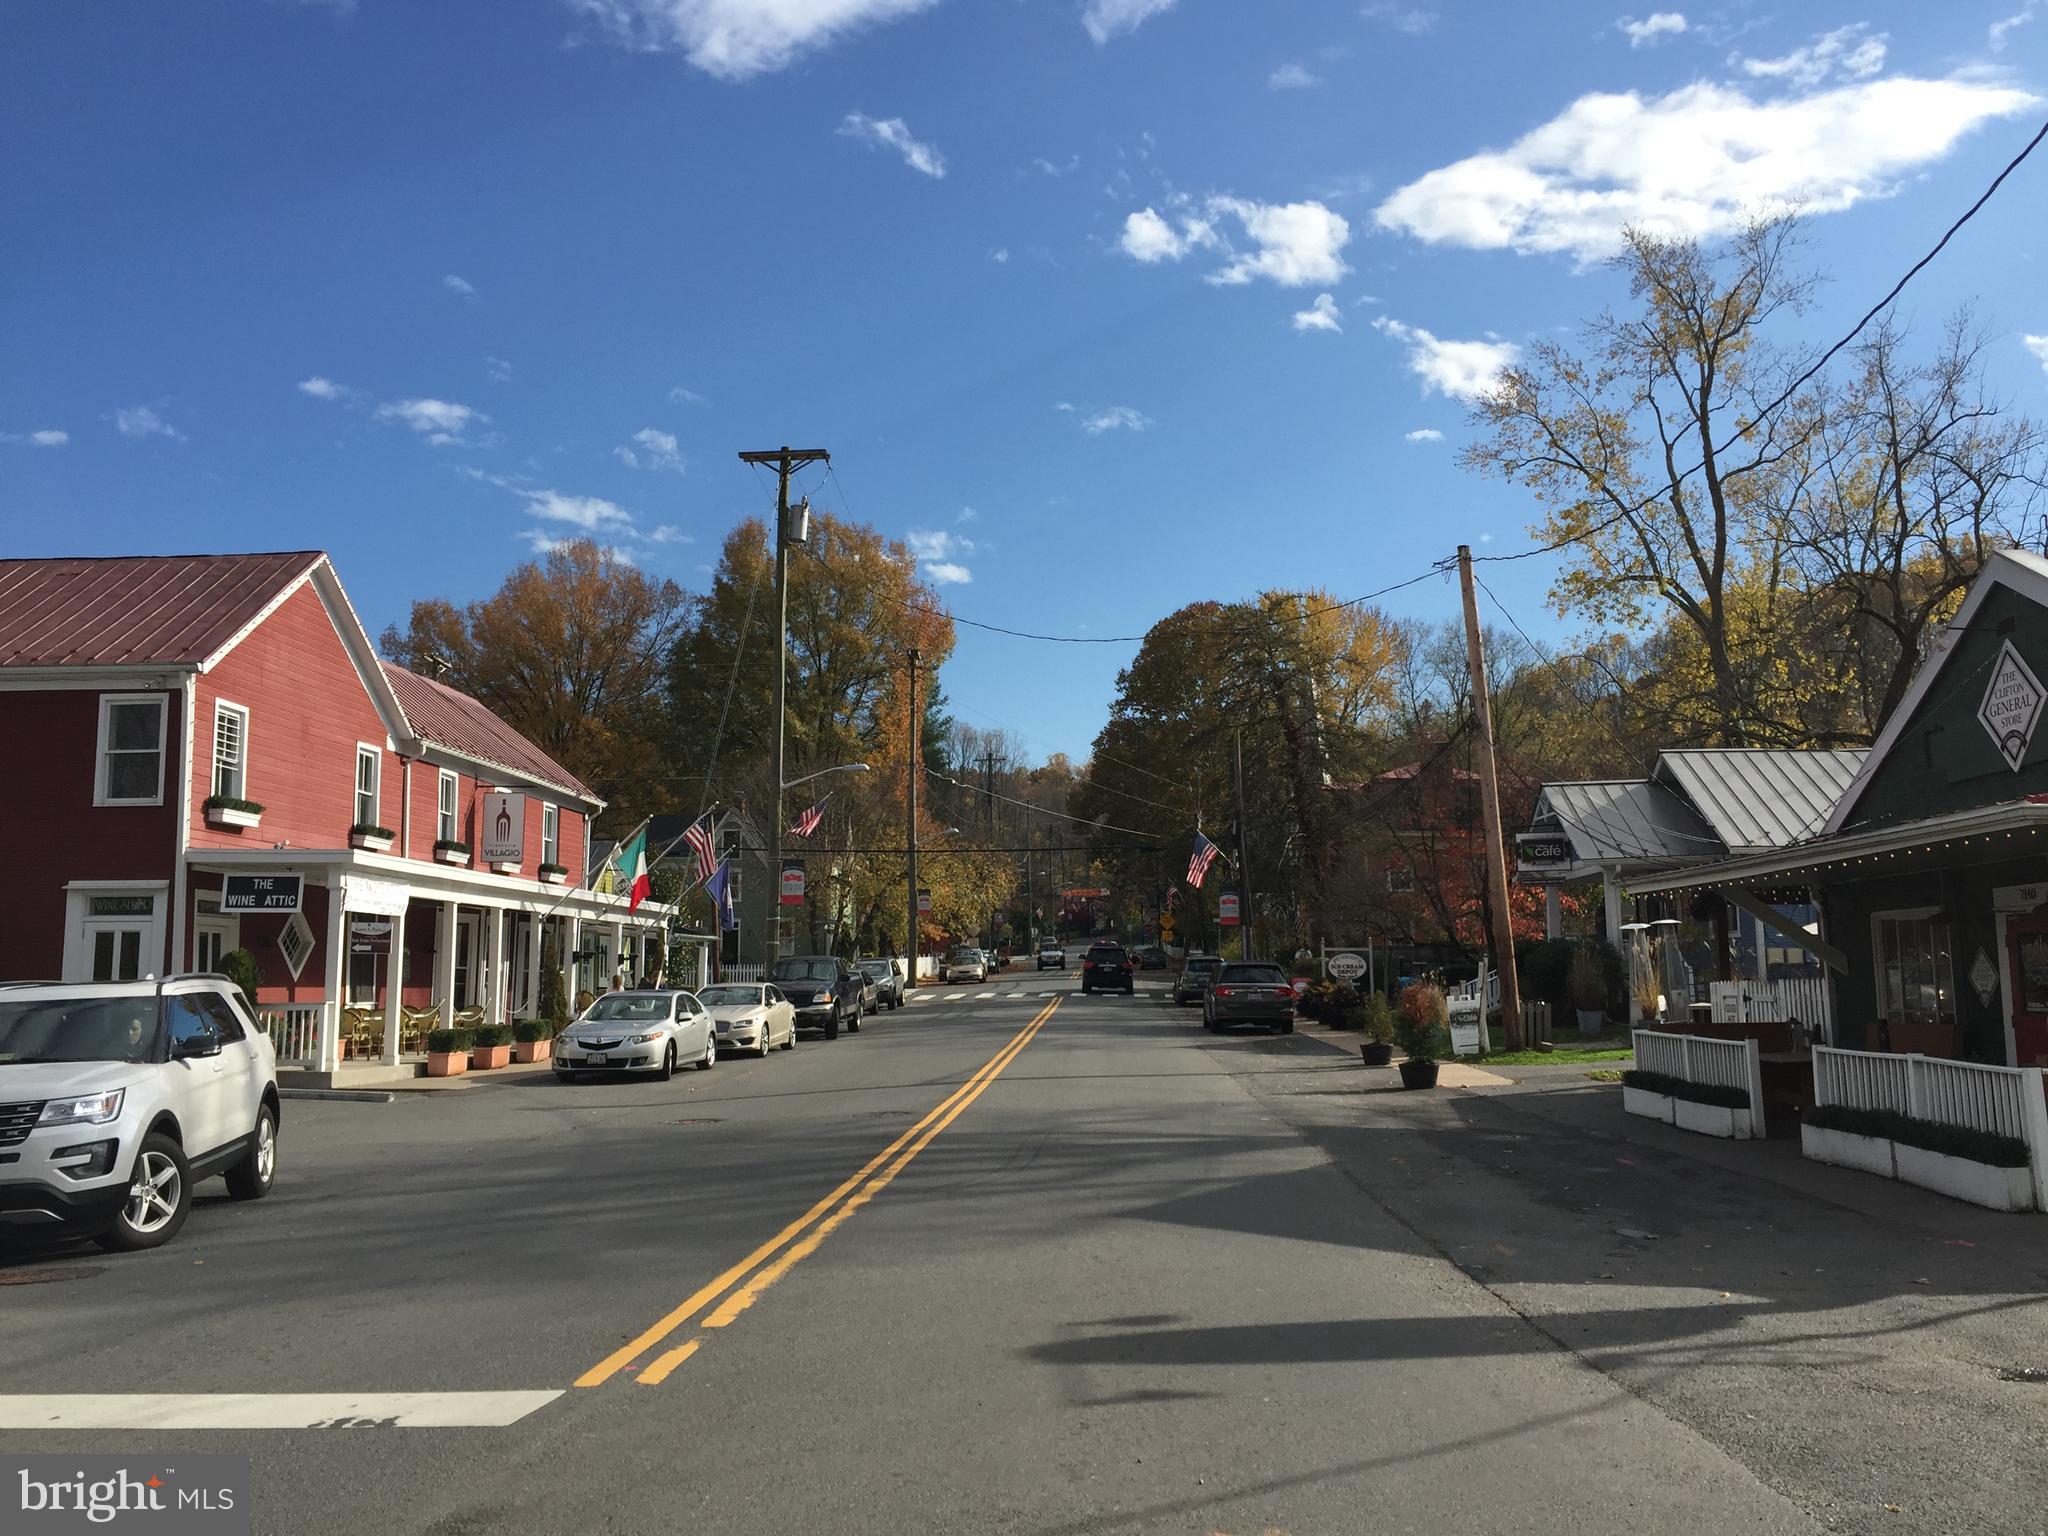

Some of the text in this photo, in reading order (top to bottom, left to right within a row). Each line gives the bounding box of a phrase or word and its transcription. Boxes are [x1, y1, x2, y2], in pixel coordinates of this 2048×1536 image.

[2001, 670, 2016, 684] THE
[1995, 683, 2025, 699] CLIFTON
[1989, 694, 2032, 718] GENERAL
[2001, 713, 2022, 728] STORE
[484, 849, 520, 857] VILLAGIO
[1534, 844, 1561, 857] café
[253, 878, 274, 890] THE
[2018, 887, 2037, 900] 7140
[227, 895, 296, 906] WINE ATTIC
